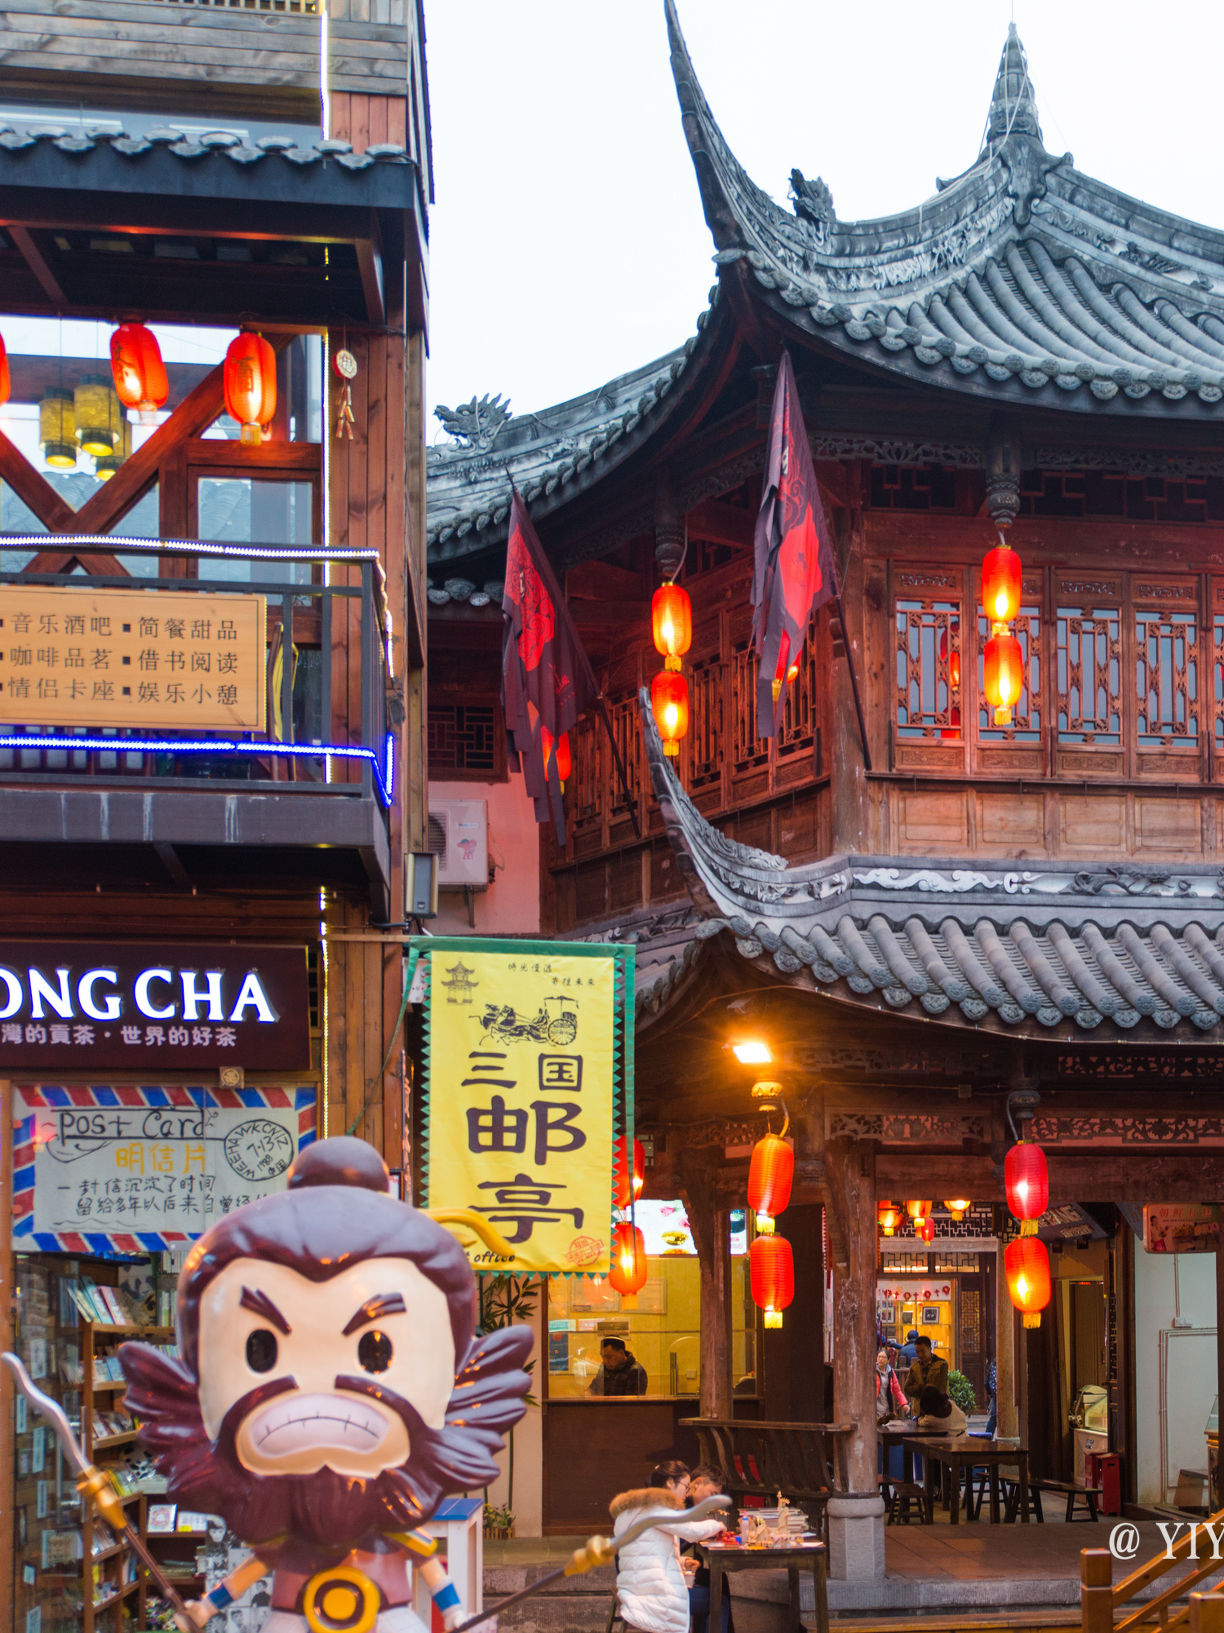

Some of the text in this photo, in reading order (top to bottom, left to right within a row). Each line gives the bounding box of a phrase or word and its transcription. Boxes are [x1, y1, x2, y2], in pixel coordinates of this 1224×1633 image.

[11, 612, 238, 640] 音乐酒吧 简餐甜品
[9, 646, 238, 674] 咖啡品茗 借书阅读
[7, 677, 238, 705] 情侣卡座 娱乐小憩
[133, 968, 277, 1023] CHA
[461, 1051, 584, 1092] 三国
[142, 1108, 205, 1138] Card
[115, 1142, 206, 1176] 明信片
